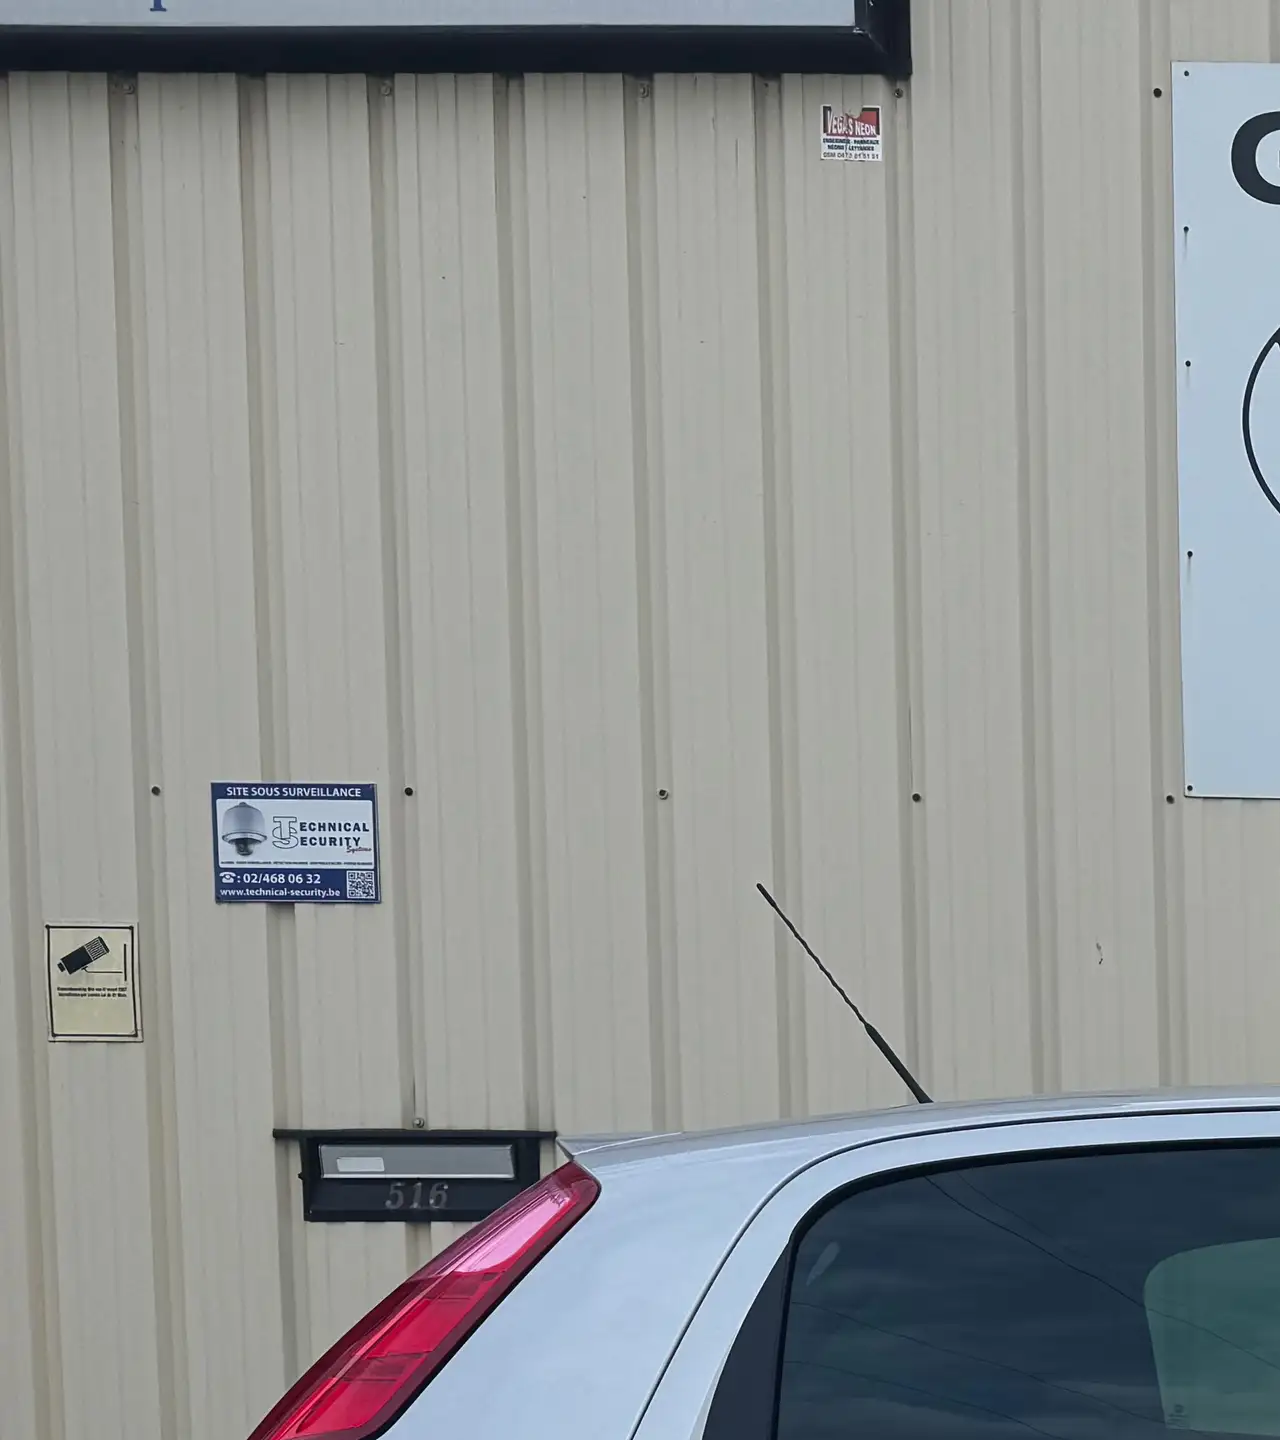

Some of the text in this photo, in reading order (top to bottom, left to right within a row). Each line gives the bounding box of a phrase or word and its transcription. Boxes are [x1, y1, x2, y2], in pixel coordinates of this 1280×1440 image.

[855, 120, 876, 136] NEON
[226, 787, 361, 797] SITE SOUS SURVEILLANCE
[243, 873, 286, 885] 02/468
[288, 874, 303, 884] 06
[306, 874, 321, 884] 32
[220, 887, 341, 898] www.technical-security.be
[385, 1182, 449, 1210] 516
